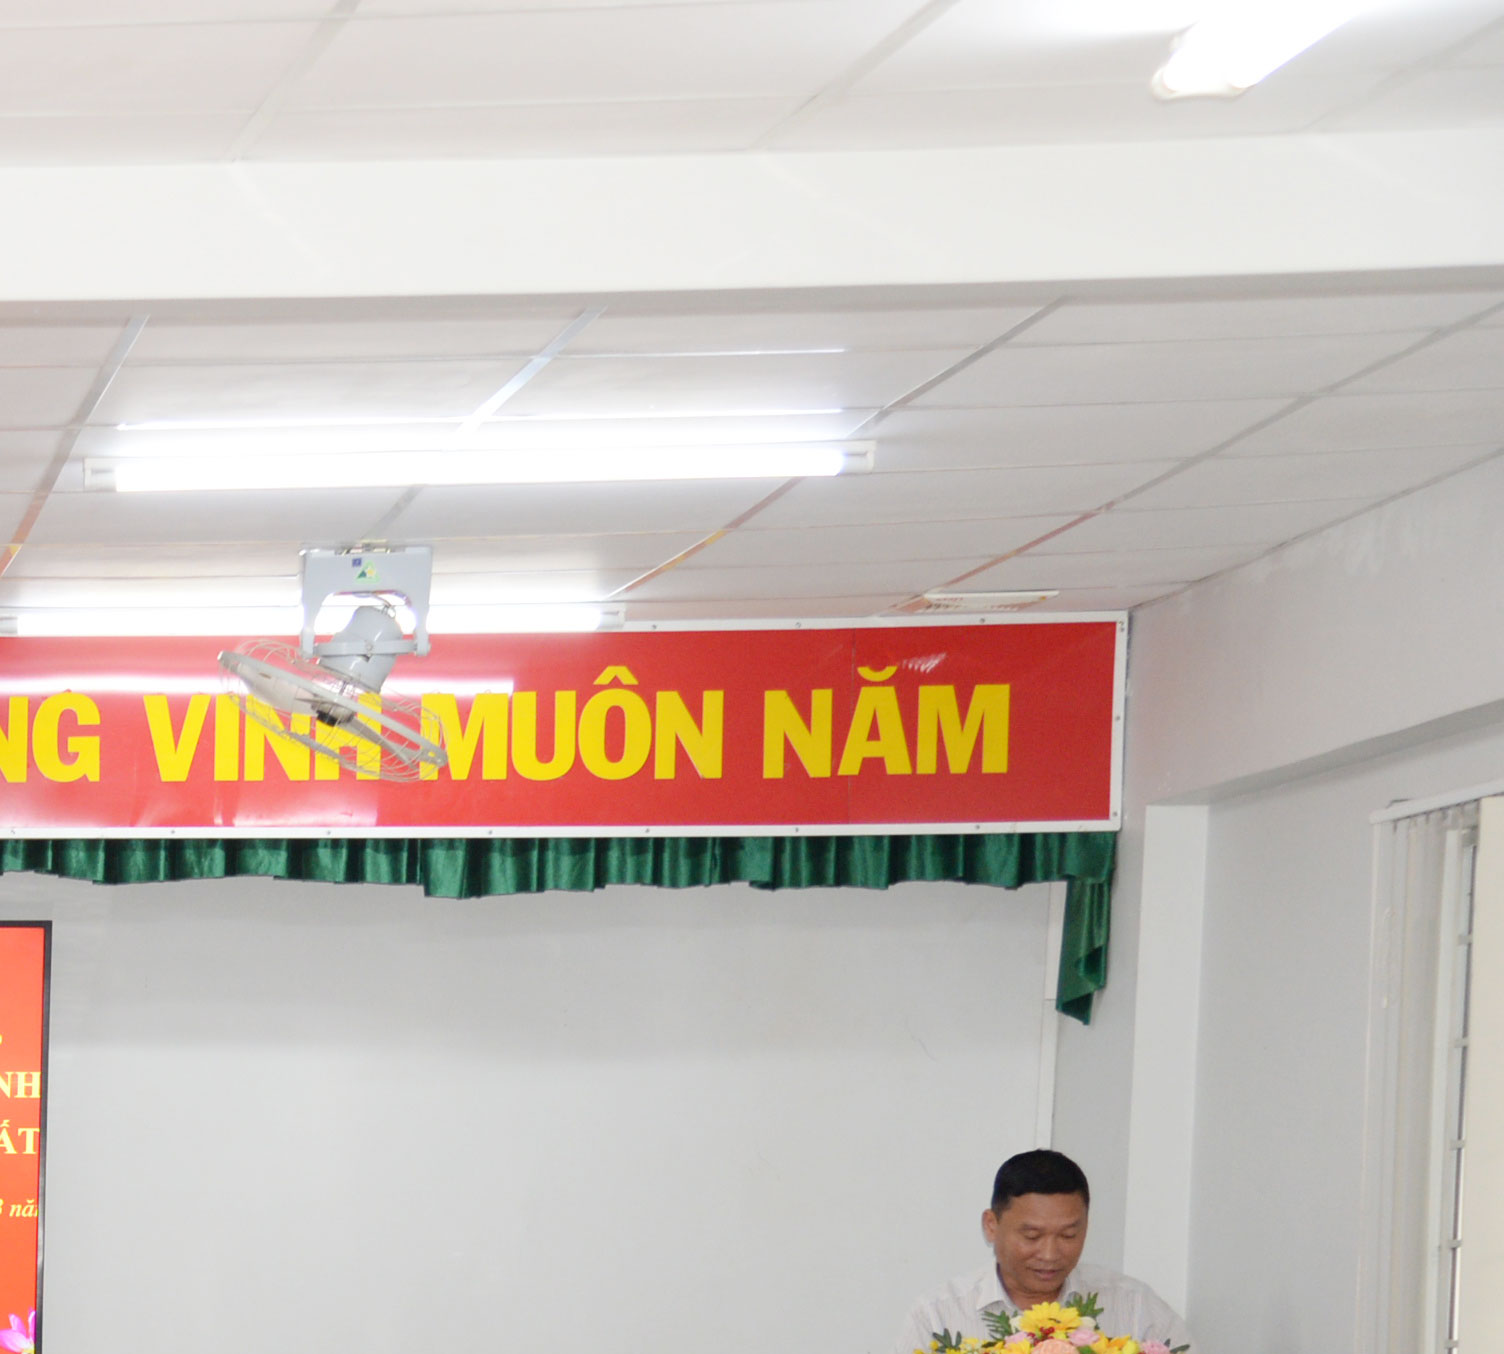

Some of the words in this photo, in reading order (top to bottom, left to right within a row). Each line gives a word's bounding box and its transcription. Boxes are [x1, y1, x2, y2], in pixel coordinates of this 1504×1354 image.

[143, 692, 382, 782] VINH
[420, 665, 725, 781] MUÔN
[763, 664, 1011, 779] NĂM
